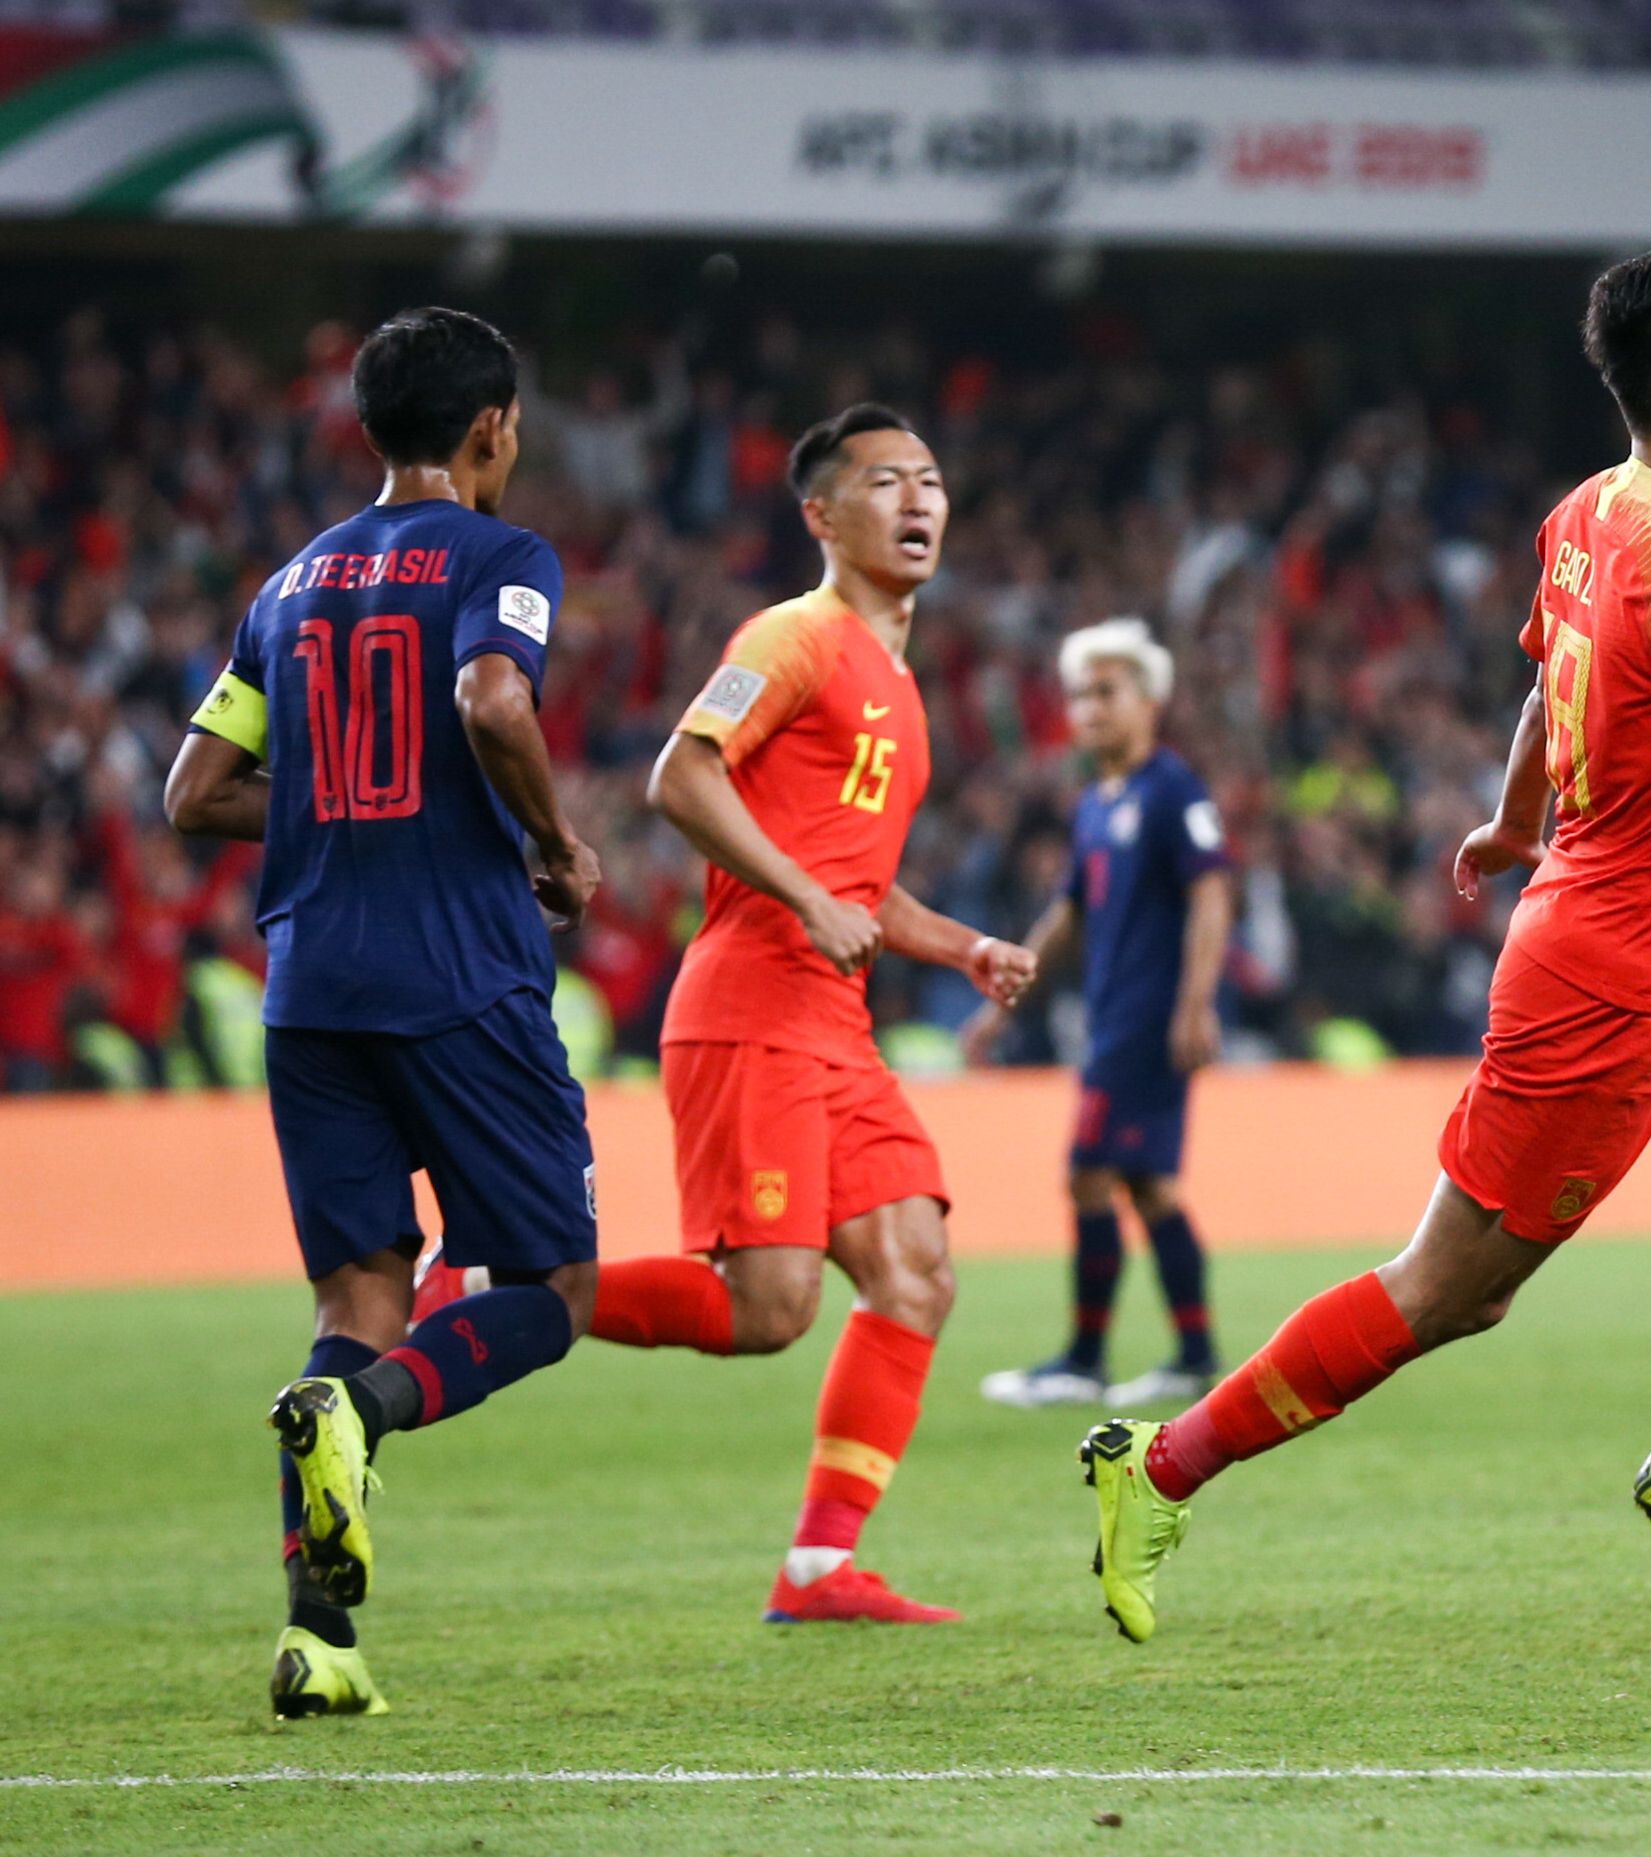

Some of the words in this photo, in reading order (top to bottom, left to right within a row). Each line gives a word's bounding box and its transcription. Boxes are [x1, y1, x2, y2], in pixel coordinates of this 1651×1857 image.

[797, 112, 904, 176] AFC
[924, 112, 1081, 178] ASIAN
[1087, 114, 1204, 180] CUP
[278, 548, 449, 600] D.TEERASIL
[293, 614, 424, 822] 10
[839, 732, 898, 814] 15
